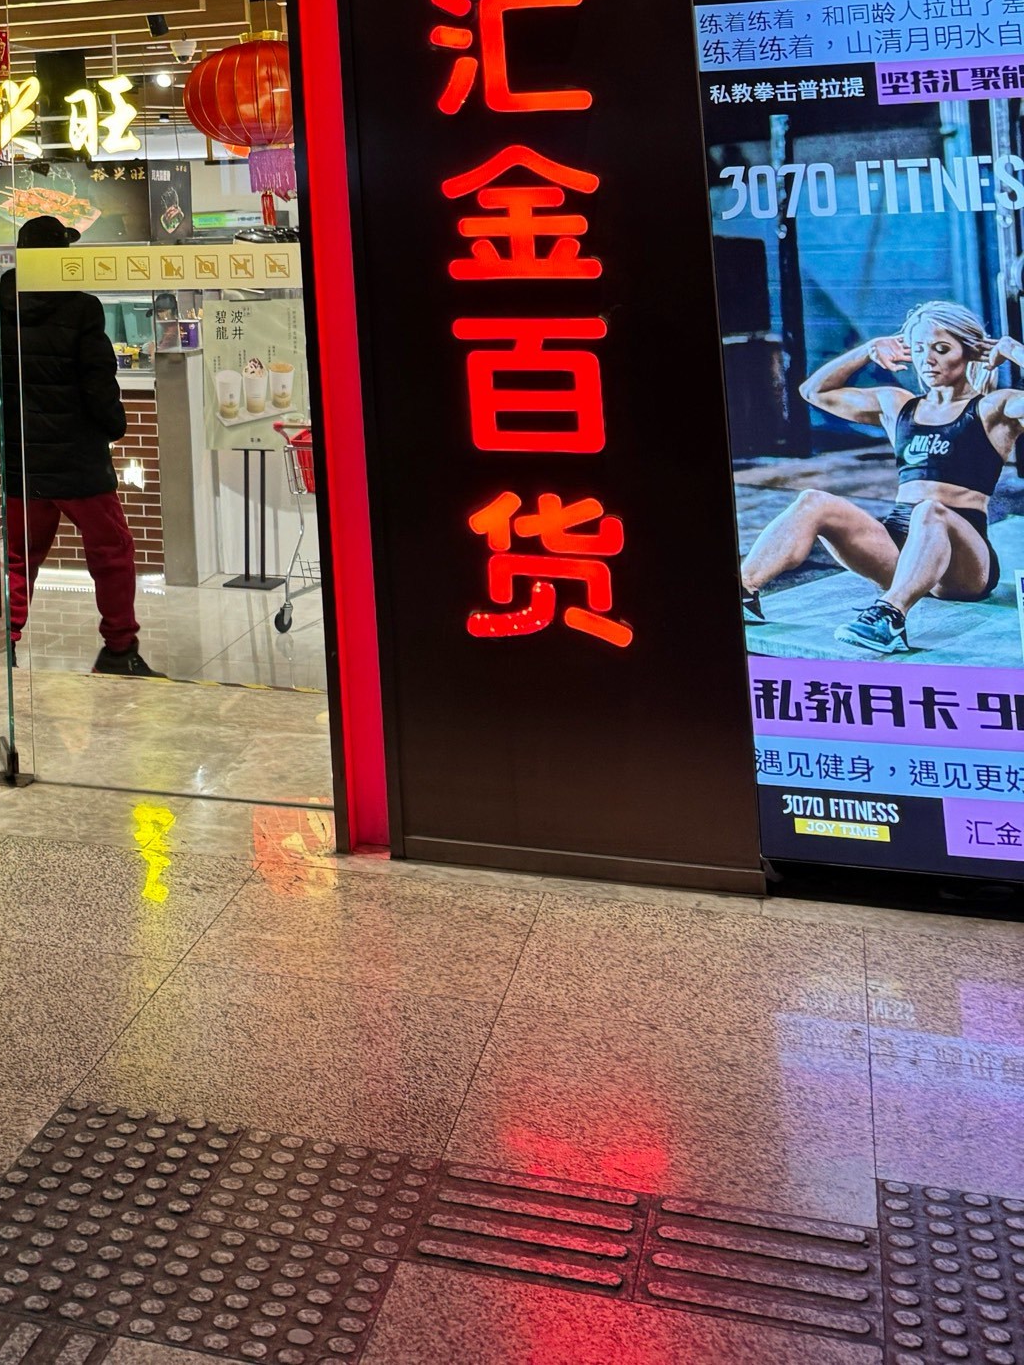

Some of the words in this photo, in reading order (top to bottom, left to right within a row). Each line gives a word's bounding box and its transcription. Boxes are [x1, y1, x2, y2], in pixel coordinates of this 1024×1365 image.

[710, 78, 865, 104] 私教拳击普拉提
[719, 163, 838, 220] 3070
[909, 434, 951, 457] Nike
[782, 794, 825, 817] 3070
[829, 797, 900, 825] FITNESS
[805, 819, 835, 835] JOY
[841, 822, 881, 839] TIME
[966, 819, 1023, 848] 汇金
